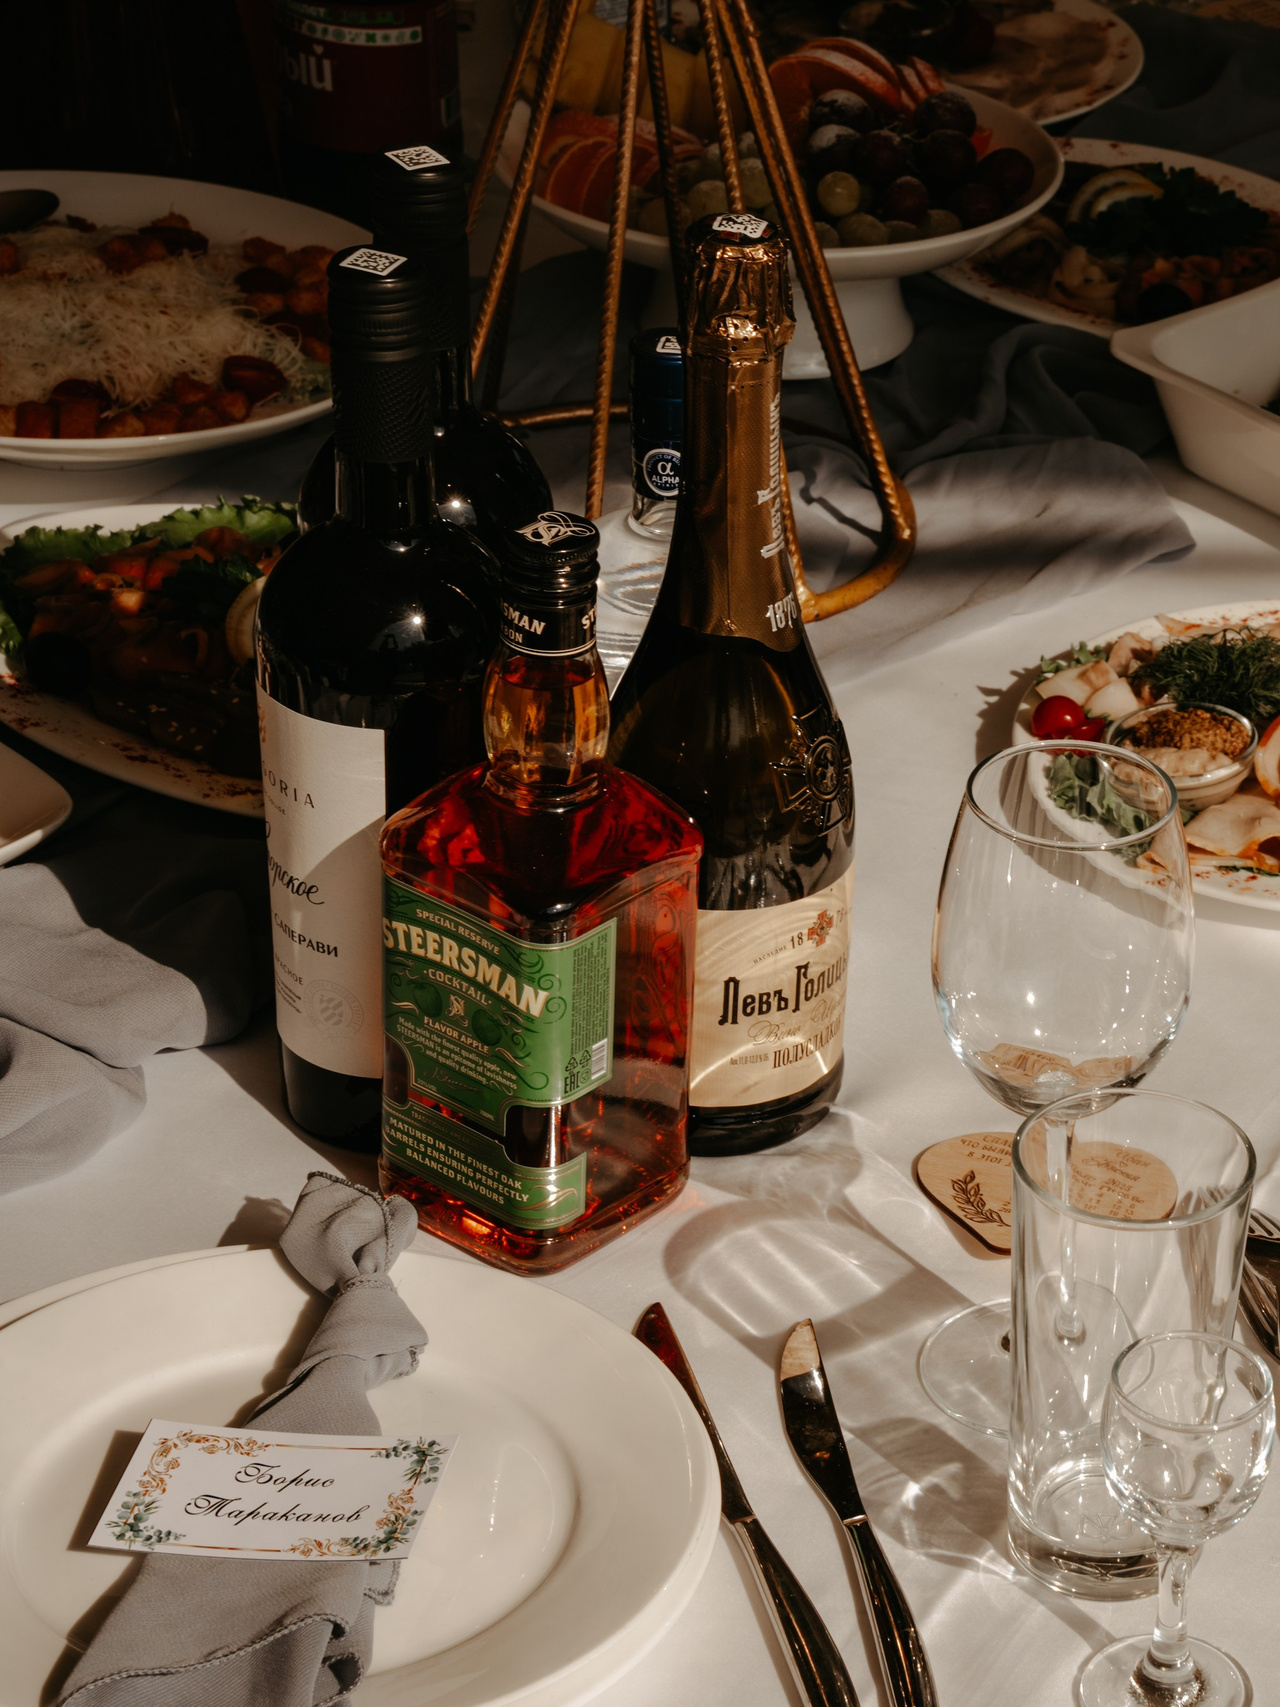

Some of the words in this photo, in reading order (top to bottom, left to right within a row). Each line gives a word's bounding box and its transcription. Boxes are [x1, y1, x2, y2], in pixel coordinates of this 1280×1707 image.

[651, 475, 680, 484] ALPHA
[503, 602, 546, 635] SMAN
[265, 767, 315, 809] ORIA
[274, 913, 338, 958] САПЕРАВИ
[416, 909, 456, 931] SPECIAL
[458, 926, 500, 955] RESERVE
[789, 932, 804, 950] 18
[383, 917, 550, 1018] STEERSMAN
[429, 968, 488, 1005] COCKTAIL
[718, 976, 789, 1026] Левъ
[397, 1024, 434, 1048] STEERSMAN
[424, 1016, 459, 1039] FLAVOR
[461, 1035, 489, 1054] APPLE
[772, 1016, 841, 1069] ПОЛУСЛАДКО
[385, 1124, 425, 1152] BARRELS
[427, 1148, 474, 1177] ENSURING
[476, 1172, 530, 1202] PERFECTLY
[389, 1116, 434, 1145] MATURED
[435, 1140, 446, 1151] IN
[448, 1145, 466, 1162] THE
[467, 1156, 500, 1179] FINEST
[501, 1174, 522, 1190] OAK
[960, 1138, 980, 1149] ЧТО
[406, 1148, 455, 1179] BALANCED
[456, 1174, 505, 1205] FLAVOURS
[235, 1462, 335, 1493] Борис
[184, 1494, 370, 1526] Тараканов
